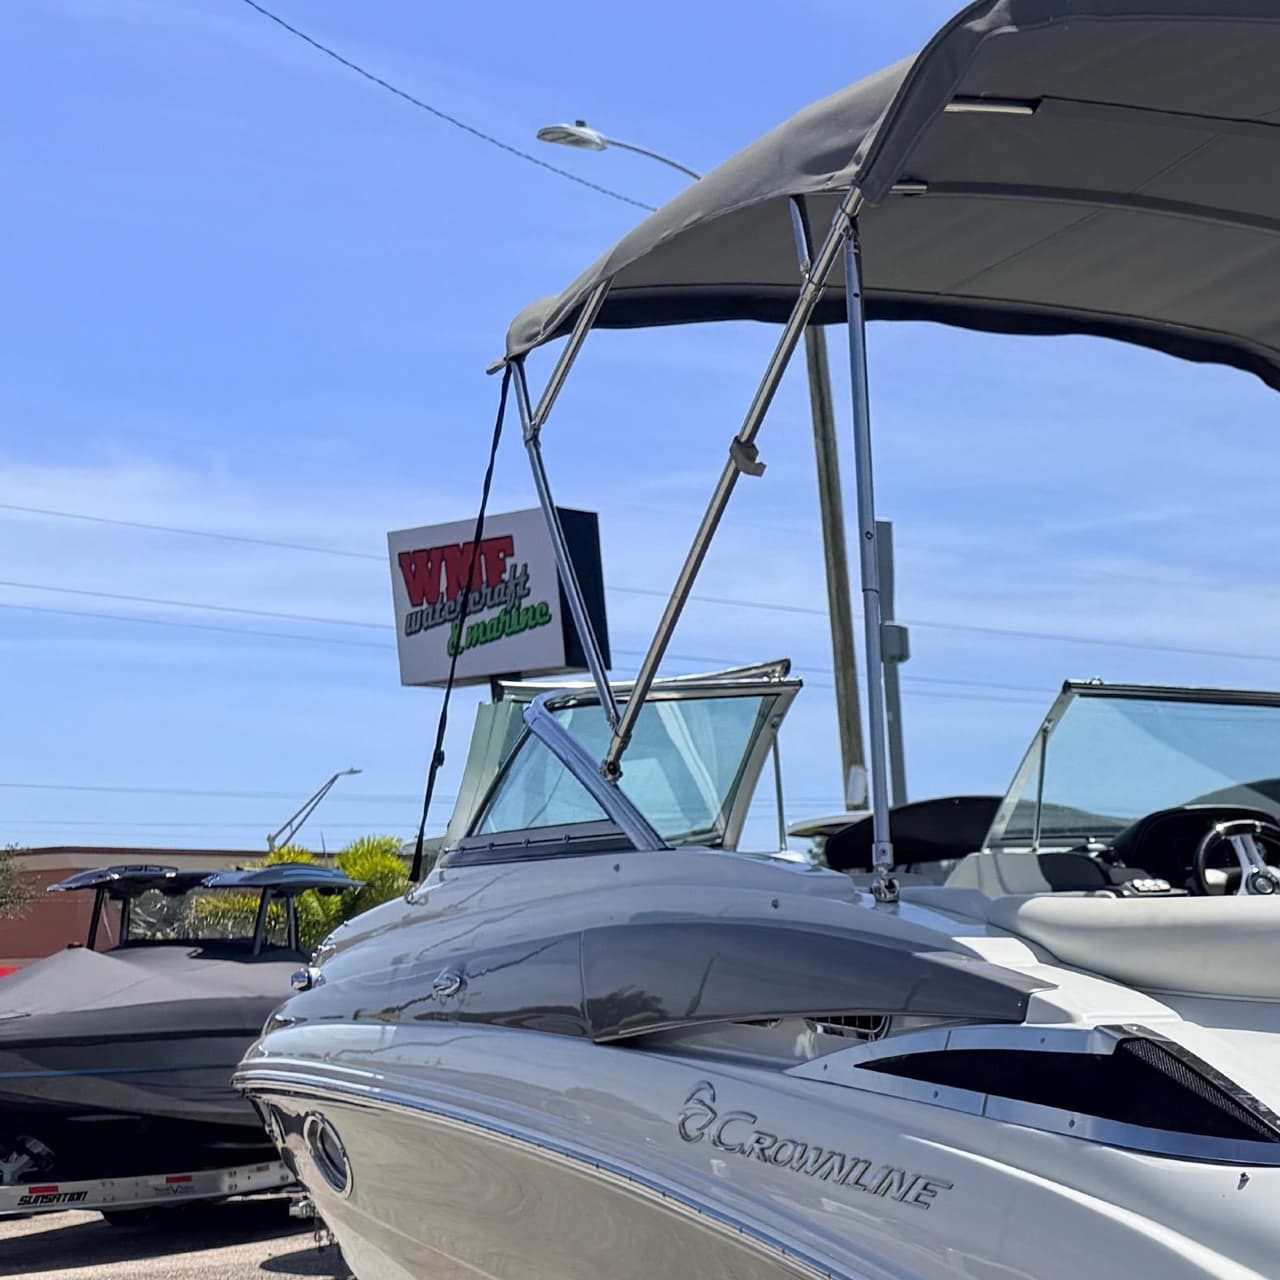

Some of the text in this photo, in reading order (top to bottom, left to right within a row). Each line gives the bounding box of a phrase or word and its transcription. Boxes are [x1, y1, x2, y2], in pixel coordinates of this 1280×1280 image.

[398, 535, 514, 608] WMF
[465, 602, 552, 649] marine
[712, 1110, 953, 1210] CROWNLINE
[18, 1191, 88, 1206] SUNSATION
